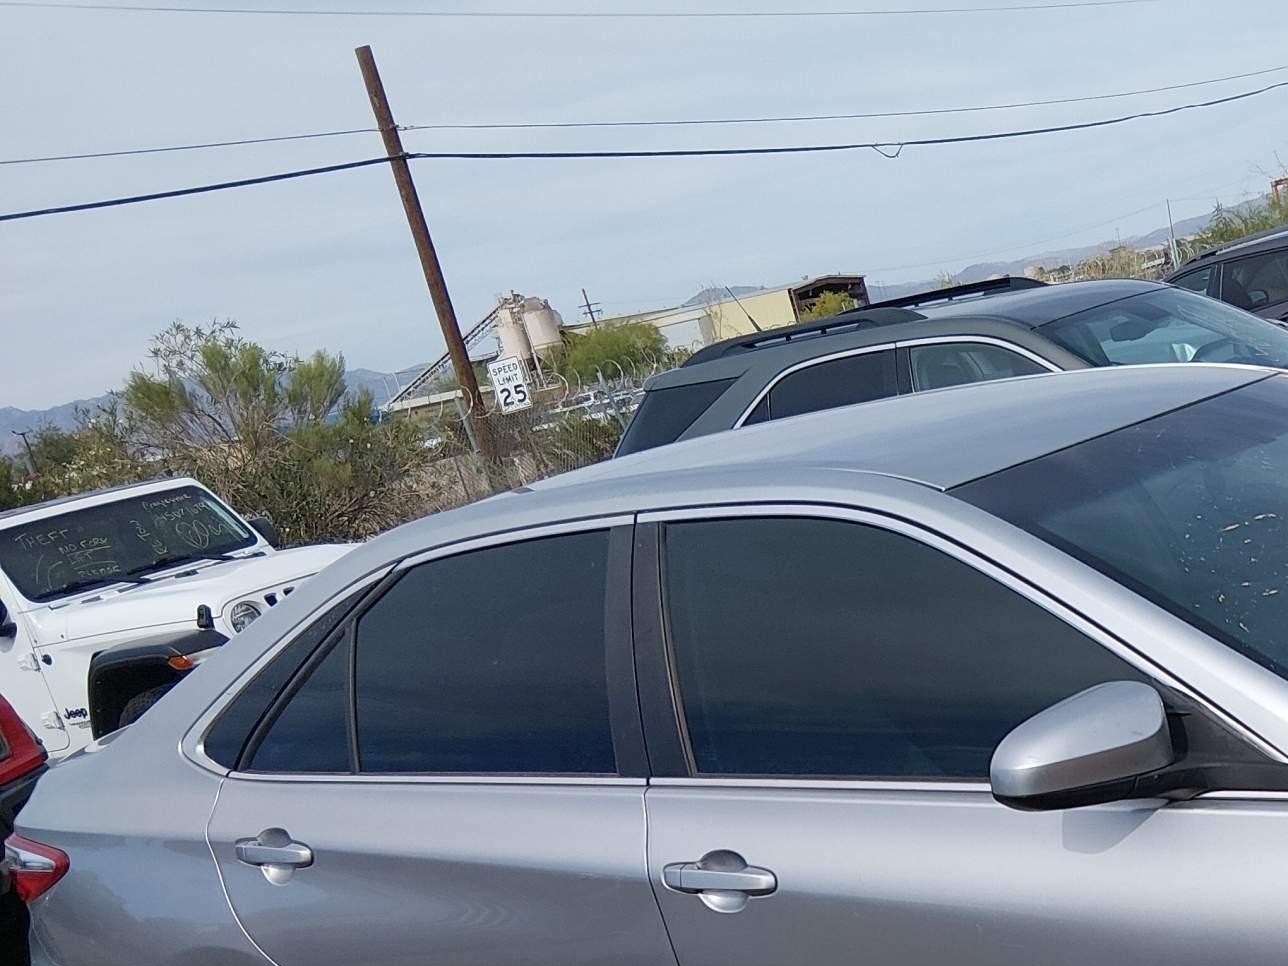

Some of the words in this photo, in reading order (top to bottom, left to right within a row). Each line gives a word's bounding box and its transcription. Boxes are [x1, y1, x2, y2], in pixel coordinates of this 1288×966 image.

[492, 362, 518, 377] SPEED
[497, 373, 518, 386] LIMIT
[500, 383, 527, 406] 25
[15, 529, 69, 551] THEFT
[64, 707, 88, 720] Jeep
